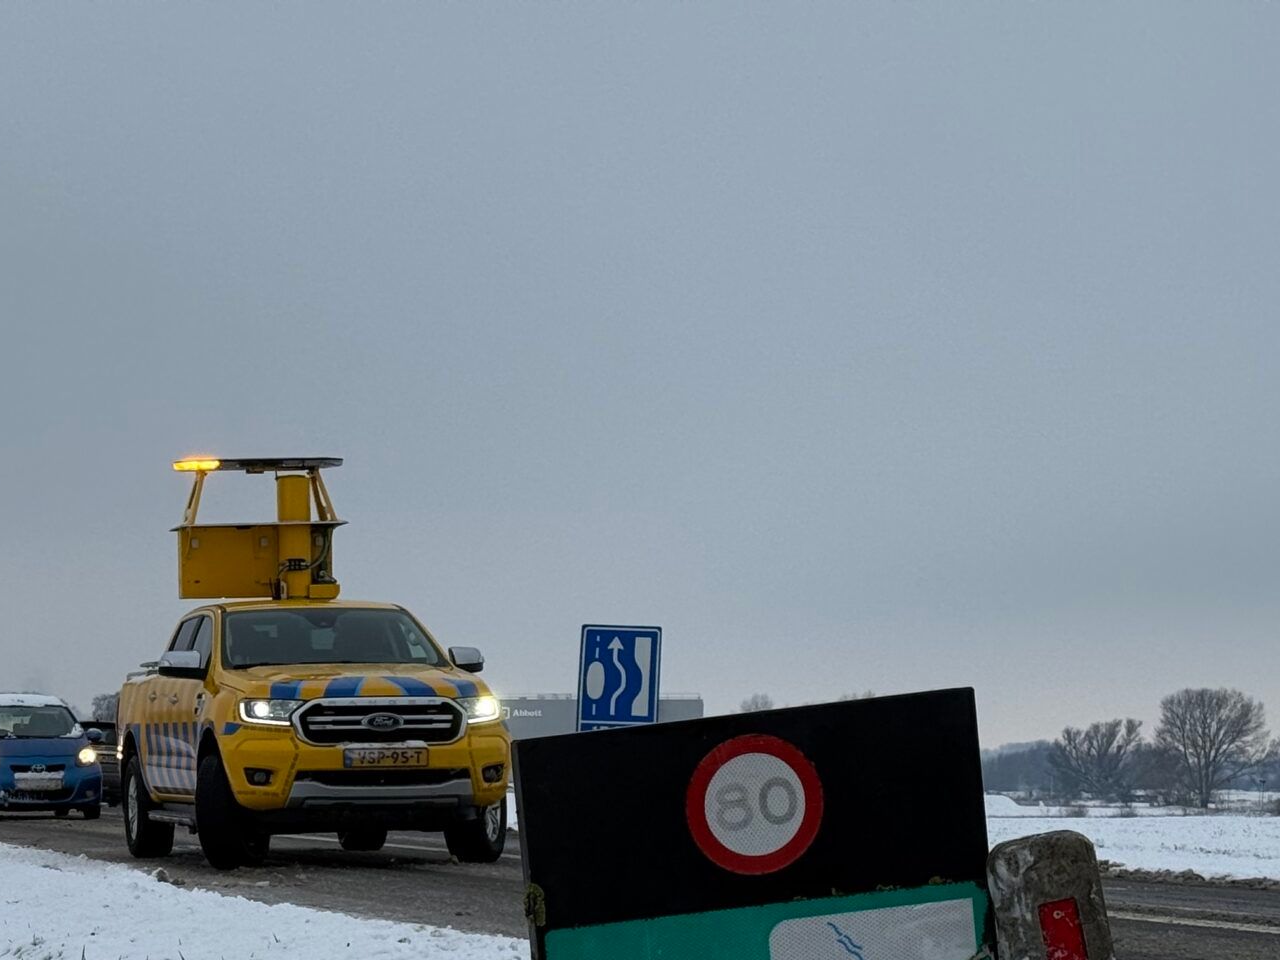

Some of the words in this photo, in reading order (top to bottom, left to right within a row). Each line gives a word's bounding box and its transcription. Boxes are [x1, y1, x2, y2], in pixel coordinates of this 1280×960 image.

[512, 708, 542, 717] Abbott
[373, 717, 394, 726] Ford
[357, 751, 423, 765] VSP-95-T
[715, 776, 798, 832] 80
